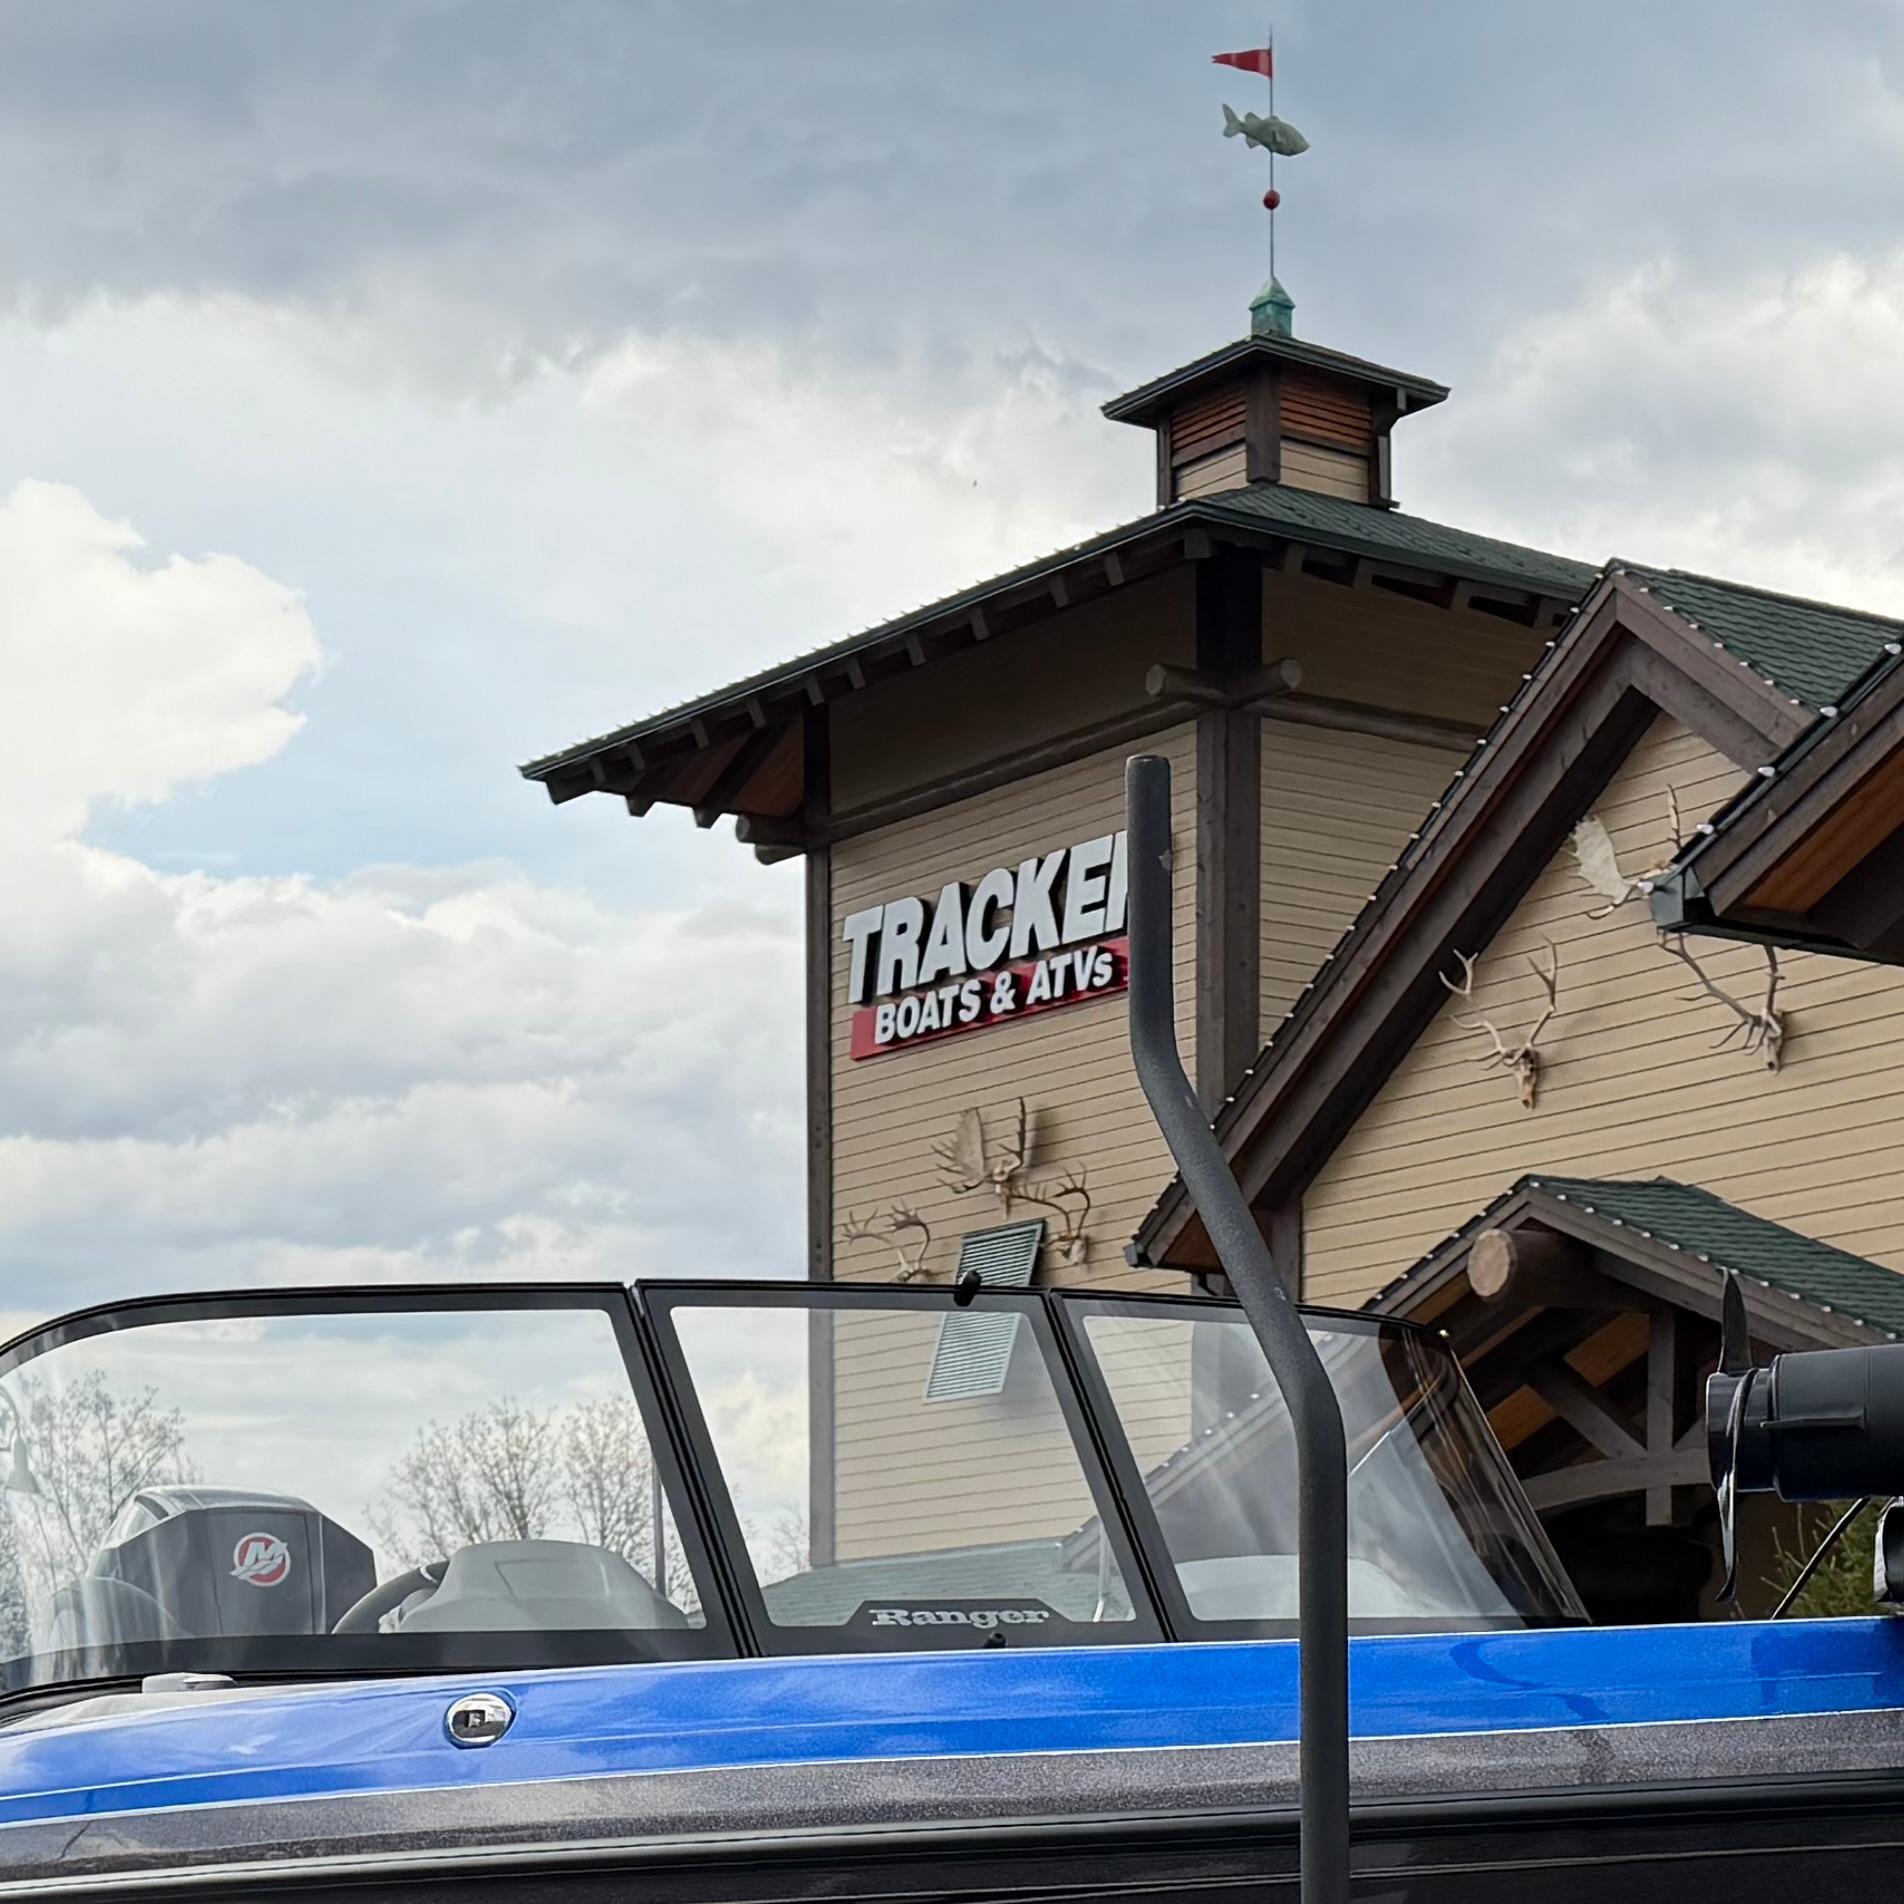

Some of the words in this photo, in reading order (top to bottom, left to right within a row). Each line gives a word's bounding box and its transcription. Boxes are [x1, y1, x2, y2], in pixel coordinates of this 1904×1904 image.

[874, 979, 981, 1045] BOATS
[990, 972, 1016, 1014] &
[1026, 945, 1113, 1005] ATVs
[868, 1608, 1050, 1630] Ranger
